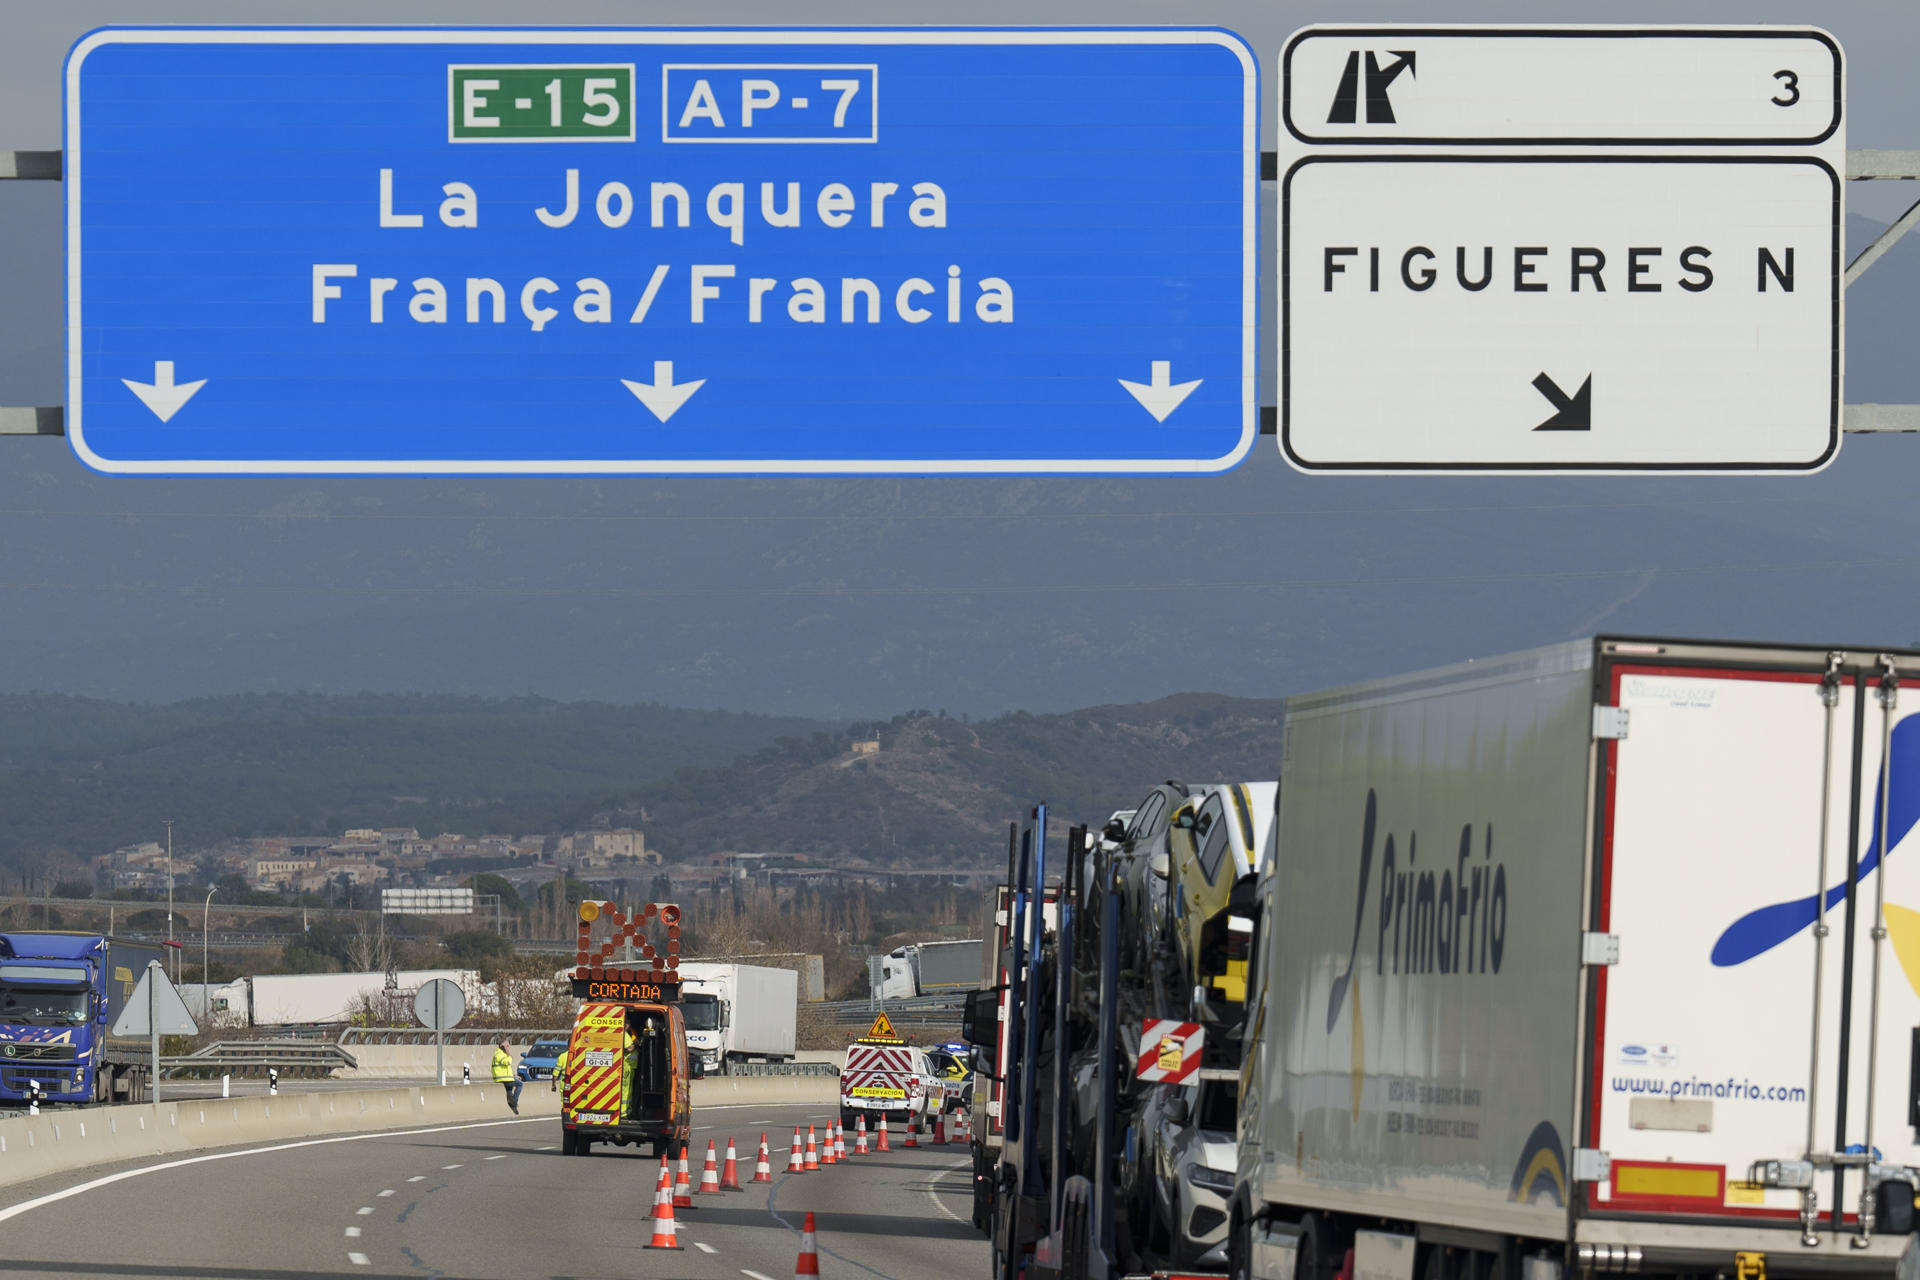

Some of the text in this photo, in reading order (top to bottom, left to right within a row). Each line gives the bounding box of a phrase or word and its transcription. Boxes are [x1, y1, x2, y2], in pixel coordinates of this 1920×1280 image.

[463, 78, 620, 128] E-15
[678, 79, 860, 128] AP-7
[1770, 69, 1800, 108] 3
[379, 168, 947, 246] La Jonquera
[1323, 245, 1795, 293] FIGUERES N
[589, 982, 661, 999] CORTADA
[591, 1018, 623, 1026] CONSER
[1611, 1075, 1806, 1103] www.primafrio.com
